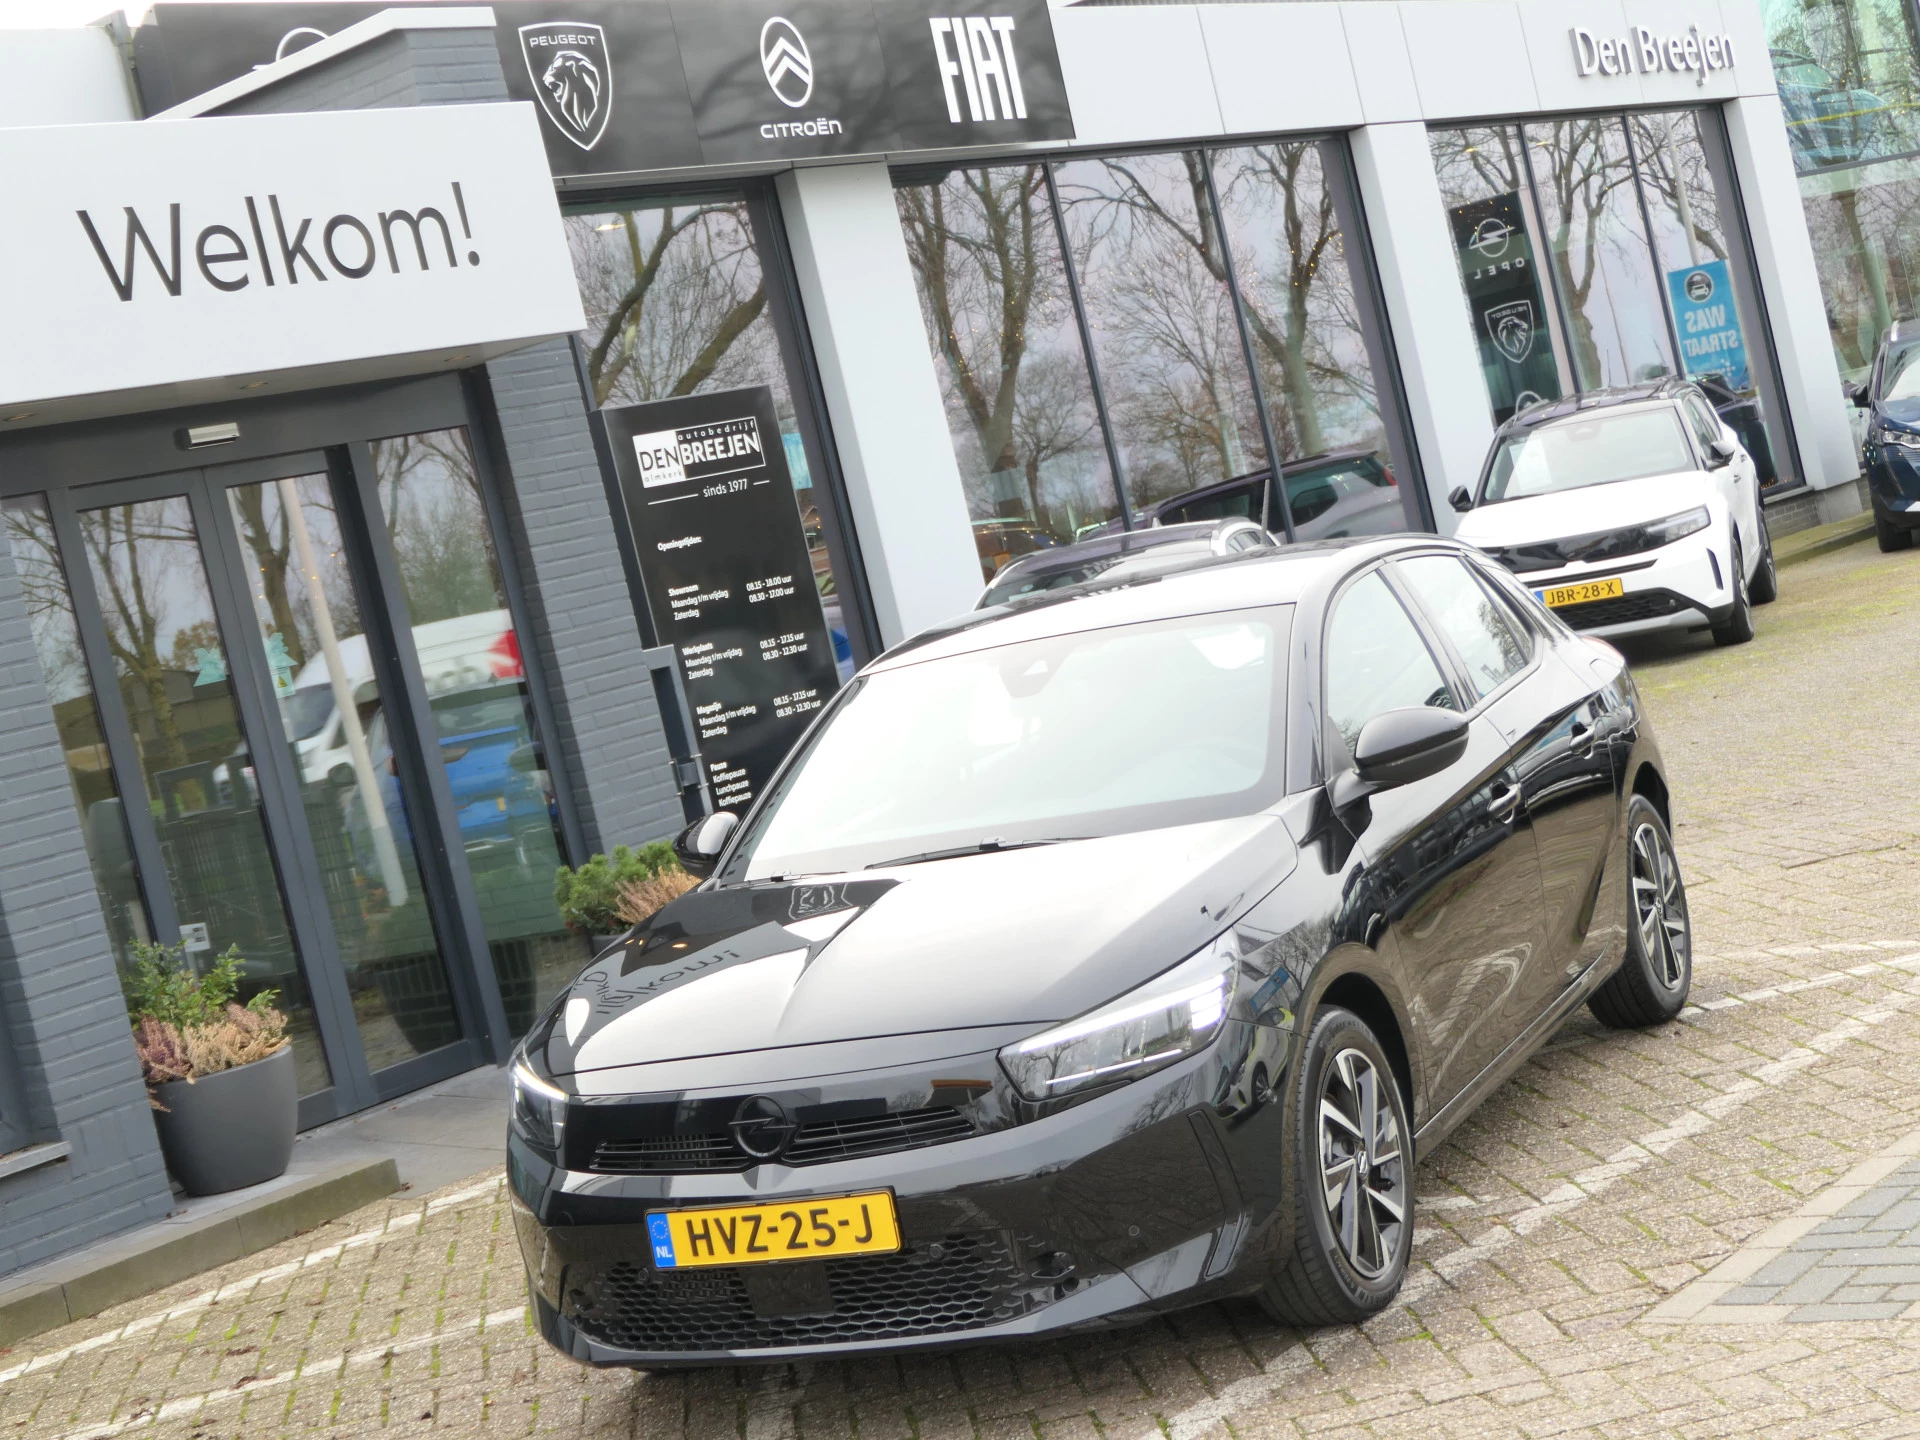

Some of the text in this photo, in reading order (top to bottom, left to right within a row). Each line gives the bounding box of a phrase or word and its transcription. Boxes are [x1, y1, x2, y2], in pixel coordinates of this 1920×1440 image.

[529, 34, 597, 48] PEUGEOT
[1568, 21, 1737, 87] Den Breejen
[928, 16, 1028, 123] FIAT
[75, 181, 481, 302] Welkom!
[677, 420, 755, 441] autobedrijf
[639, 431, 761, 472] DEN BREEJEN
[703, 478, 748, 498] sinds 1977
[782, 575, 792, 584] uur
[668, 584, 699, 597] Showroom
[784, 587, 795, 595] uur
[1548, 581, 1616, 605] JBR-28-X
[671, 589, 729, 608] Maandag t/m vrijdag
[674, 608, 700, 621] Zaterdag
[794, 632, 805, 640] uur
[797, 643, 808, 652] uur
[685, 655, 712, 668] Maandag
[722, 647, 743, 659] vrijdag
[688, 667, 714, 680] Zaterdag
[806, 689, 817, 698] uur
[736, 705, 757, 716] vrijdag
[810, 700, 821, 708] uur
[702, 726, 728, 739] Zaterdag
[685, 1203, 873, 1257] HVZ-25-J
[655, 1245, 673, 1259] NL
